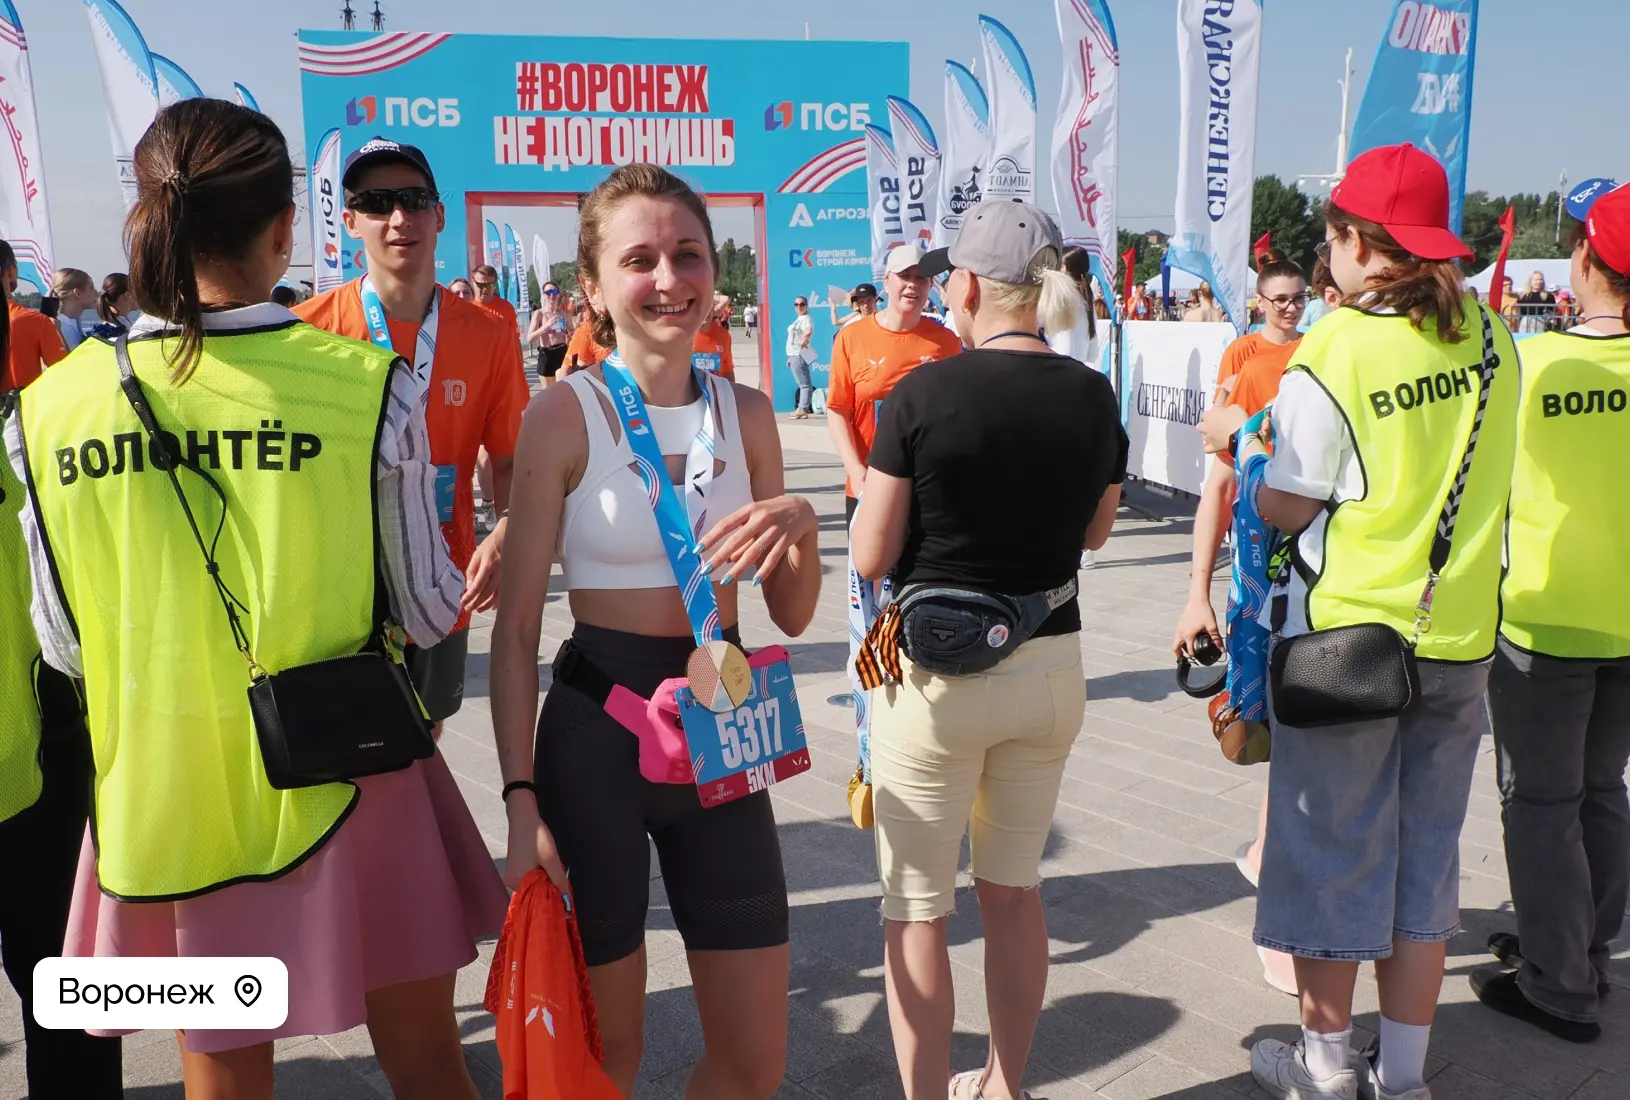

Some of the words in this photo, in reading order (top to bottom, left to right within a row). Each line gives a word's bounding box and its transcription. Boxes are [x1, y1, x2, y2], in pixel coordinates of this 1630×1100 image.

[516, 62, 709, 113] #ВОРОНЕЖ
[384, 97, 460, 128] ПСБ
[800, 102, 870, 131] ПСБ
[541, 117, 735, 172] ДОГОНИШЬ
[320, 177, 336, 238] ПСБ
[369, 305, 382, 328] ПСБ
[442, 379, 467, 406] 10
[619, 386, 640, 416] ПСБ
[1137, 382, 1206, 426] СЕНЕЖСКАЯ
[1368, 353, 1500, 420] ВОЛОНТР
[55, 419, 322, 486] ВОЛОНТЁР
[1251, 544, 1262, 567] ПСБ
[715, 697, 783, 769] 5317
